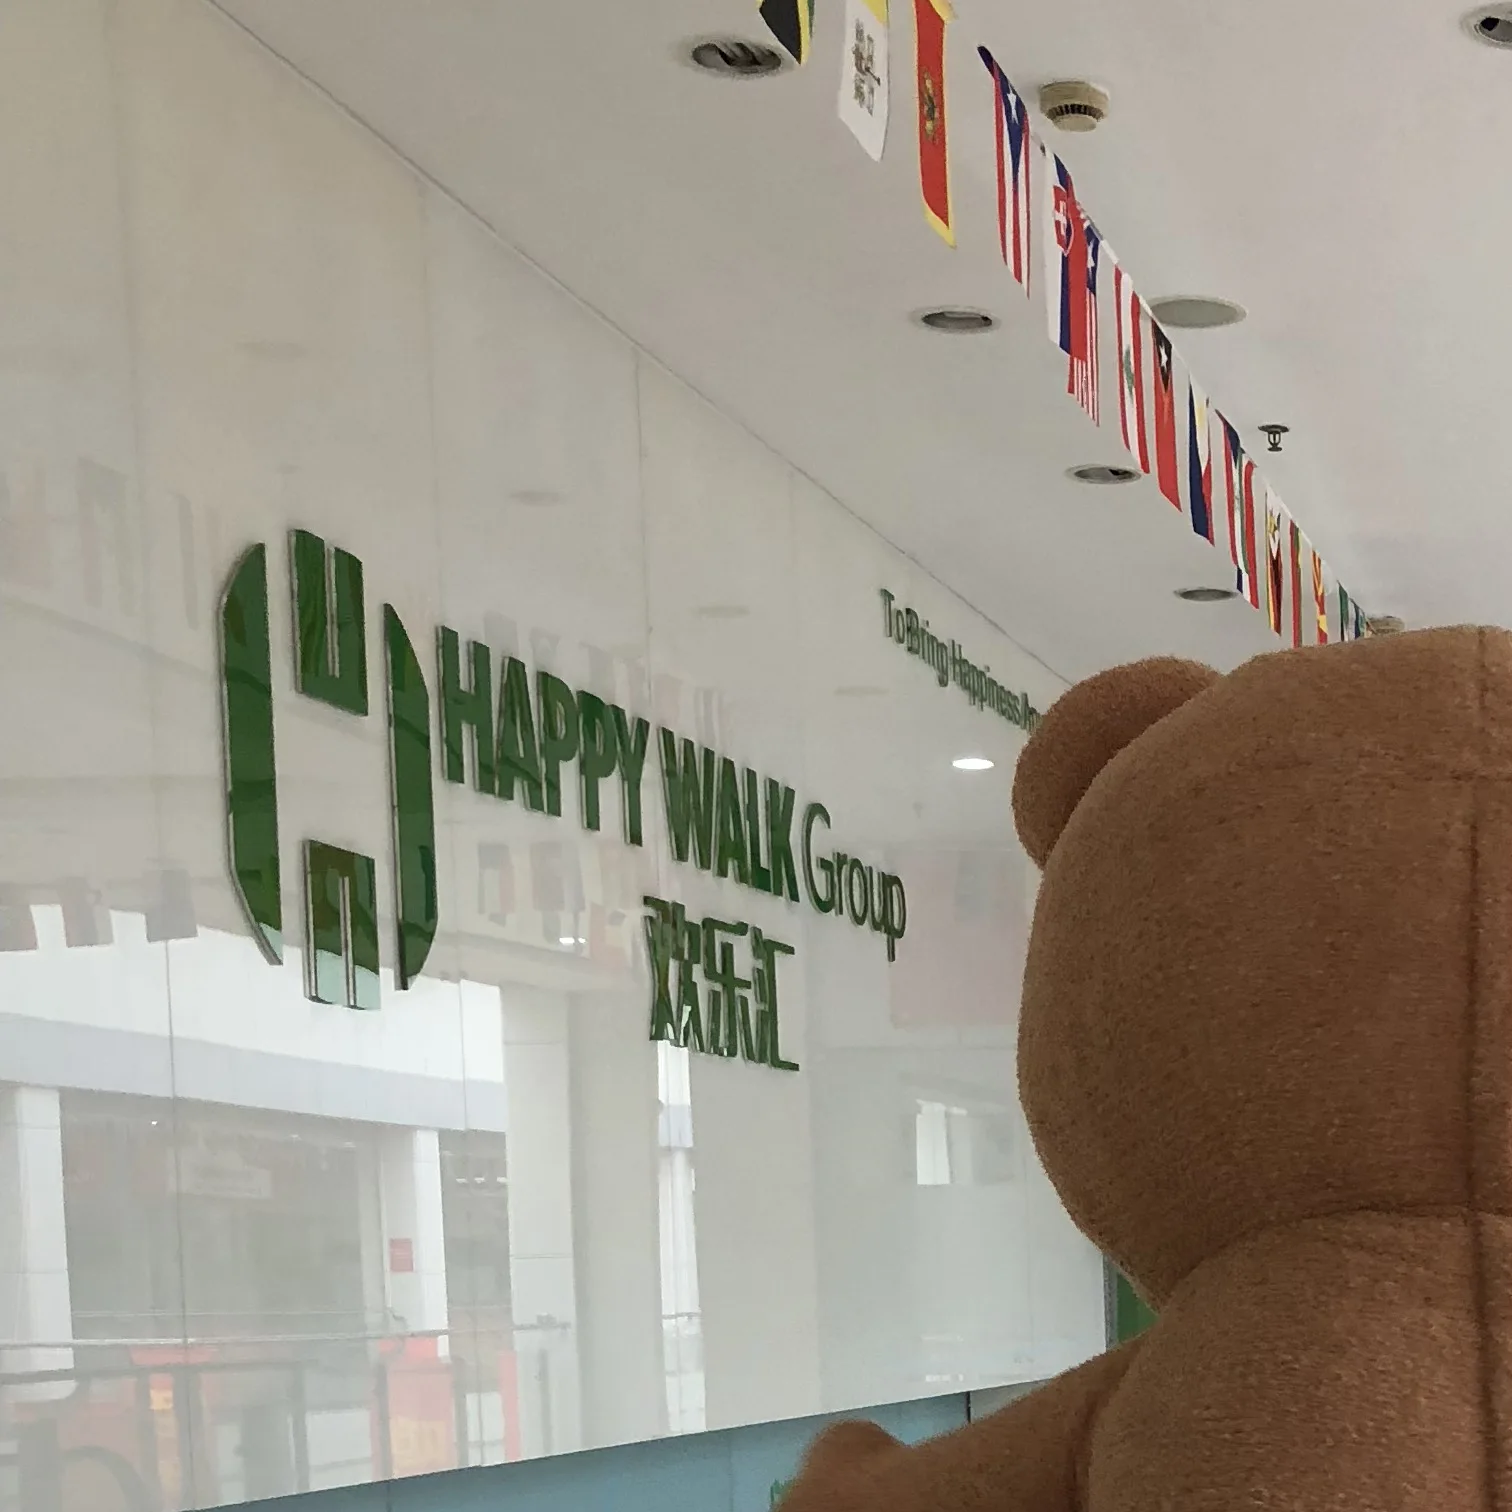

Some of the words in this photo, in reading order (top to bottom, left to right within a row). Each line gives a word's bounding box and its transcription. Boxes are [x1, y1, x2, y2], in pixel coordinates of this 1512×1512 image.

[905, 607, 949, 688] Bring
[436, 624, 650, 847] HAPPY
[657, 725, 800, 903] WALK
[801, 803, 907, 962] Group
